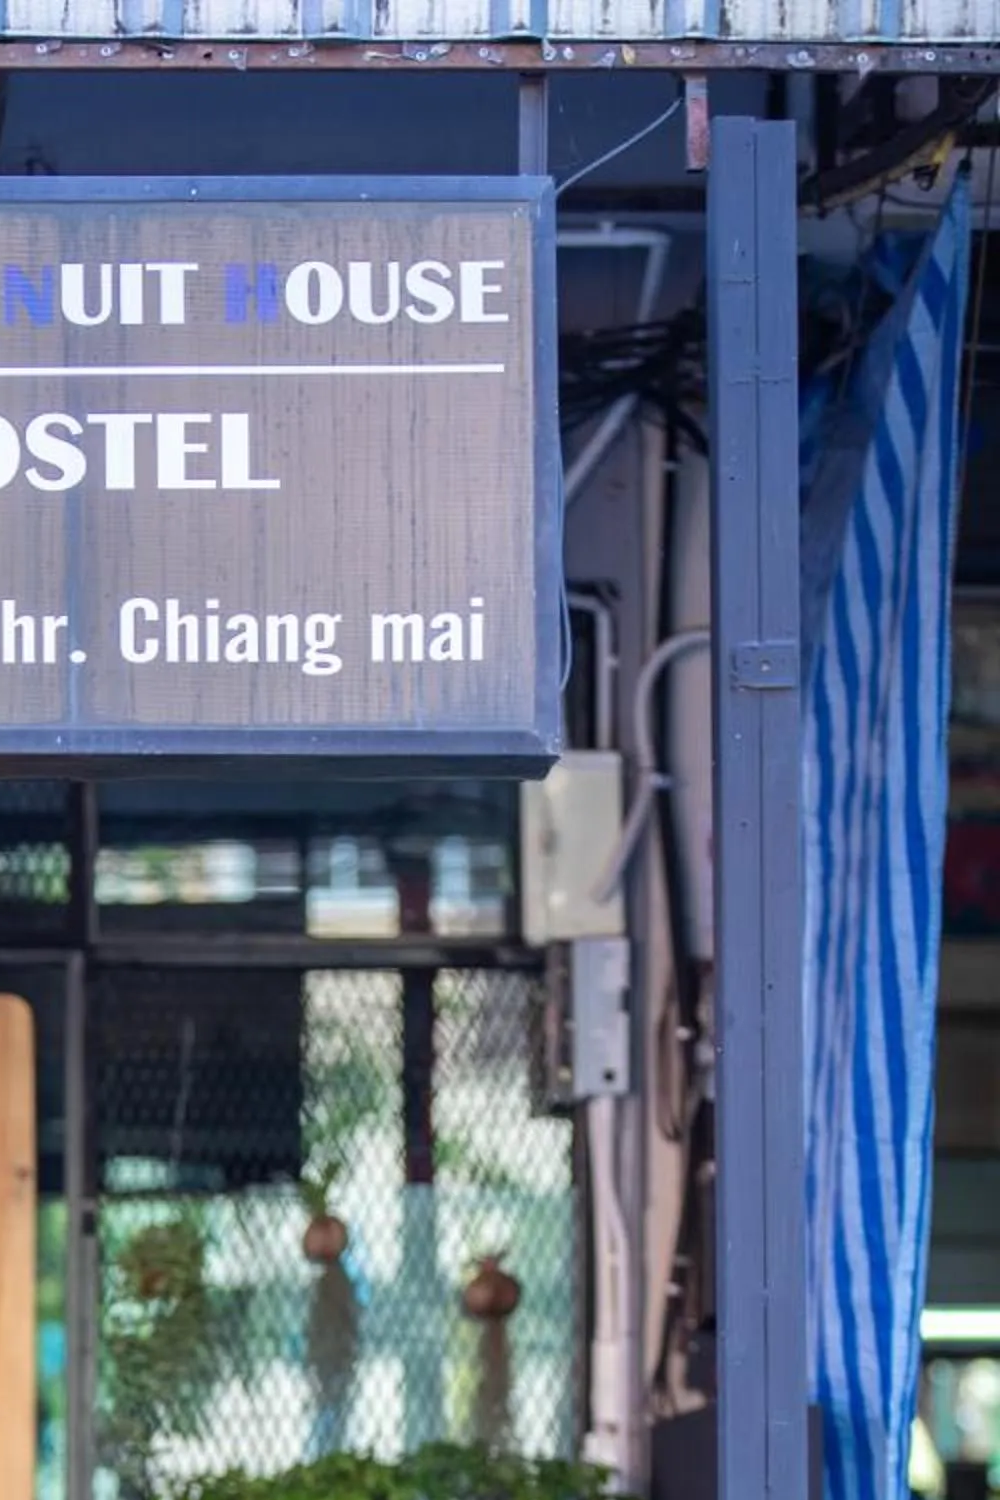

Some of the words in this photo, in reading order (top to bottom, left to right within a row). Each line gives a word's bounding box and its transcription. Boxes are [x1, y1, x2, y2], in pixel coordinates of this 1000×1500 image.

[0, 262, 200, 326] NUIT
[223, 260, 510, 325] HOUSE
[1, 599, 88, 665] hr.
[118, 597, 342, 677] Chiang
[371, 598, 486, 664] mai
